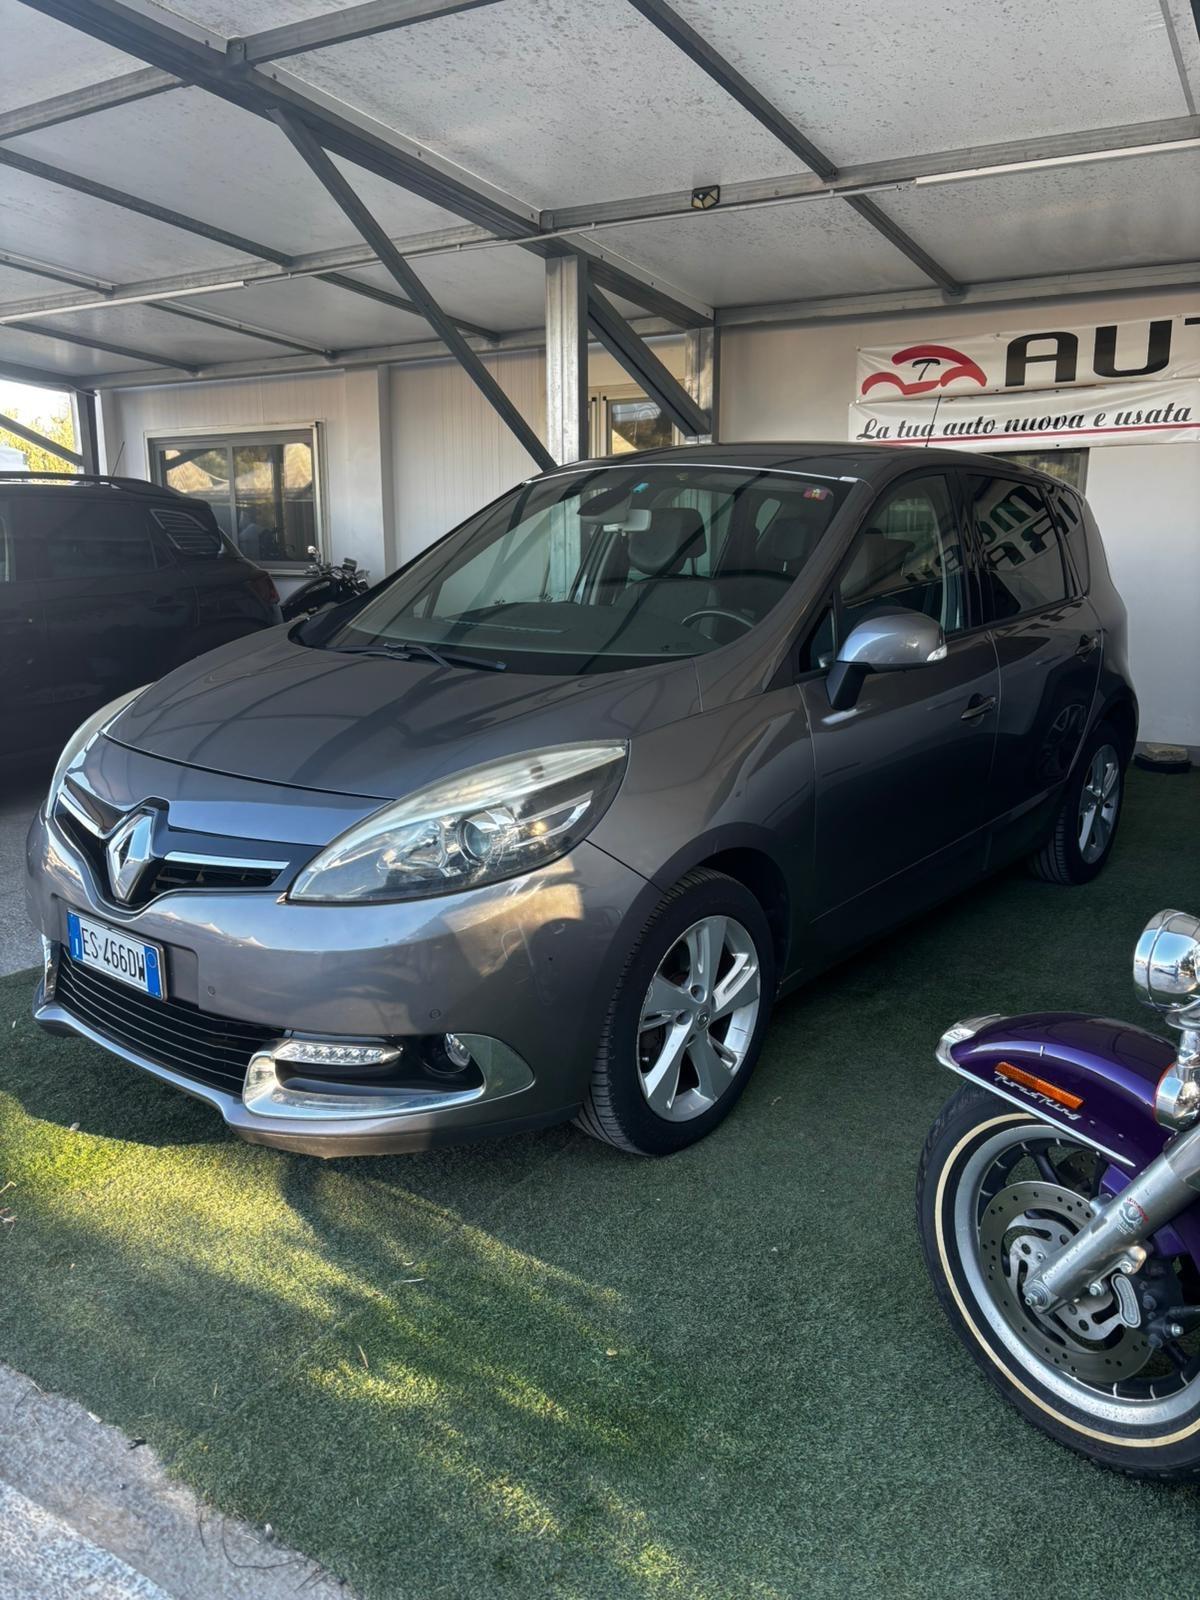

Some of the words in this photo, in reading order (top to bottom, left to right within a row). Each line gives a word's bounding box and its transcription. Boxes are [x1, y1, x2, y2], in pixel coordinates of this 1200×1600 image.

[856, 418, 890, 440] La
[897, 420, 935, 438] tua
[943, 416, 996, 436] auto
[1004, 412, 1084, 433] nuova
[1093, 412, 1106, 427] e
[1114, 402, 1192, 426] usata
